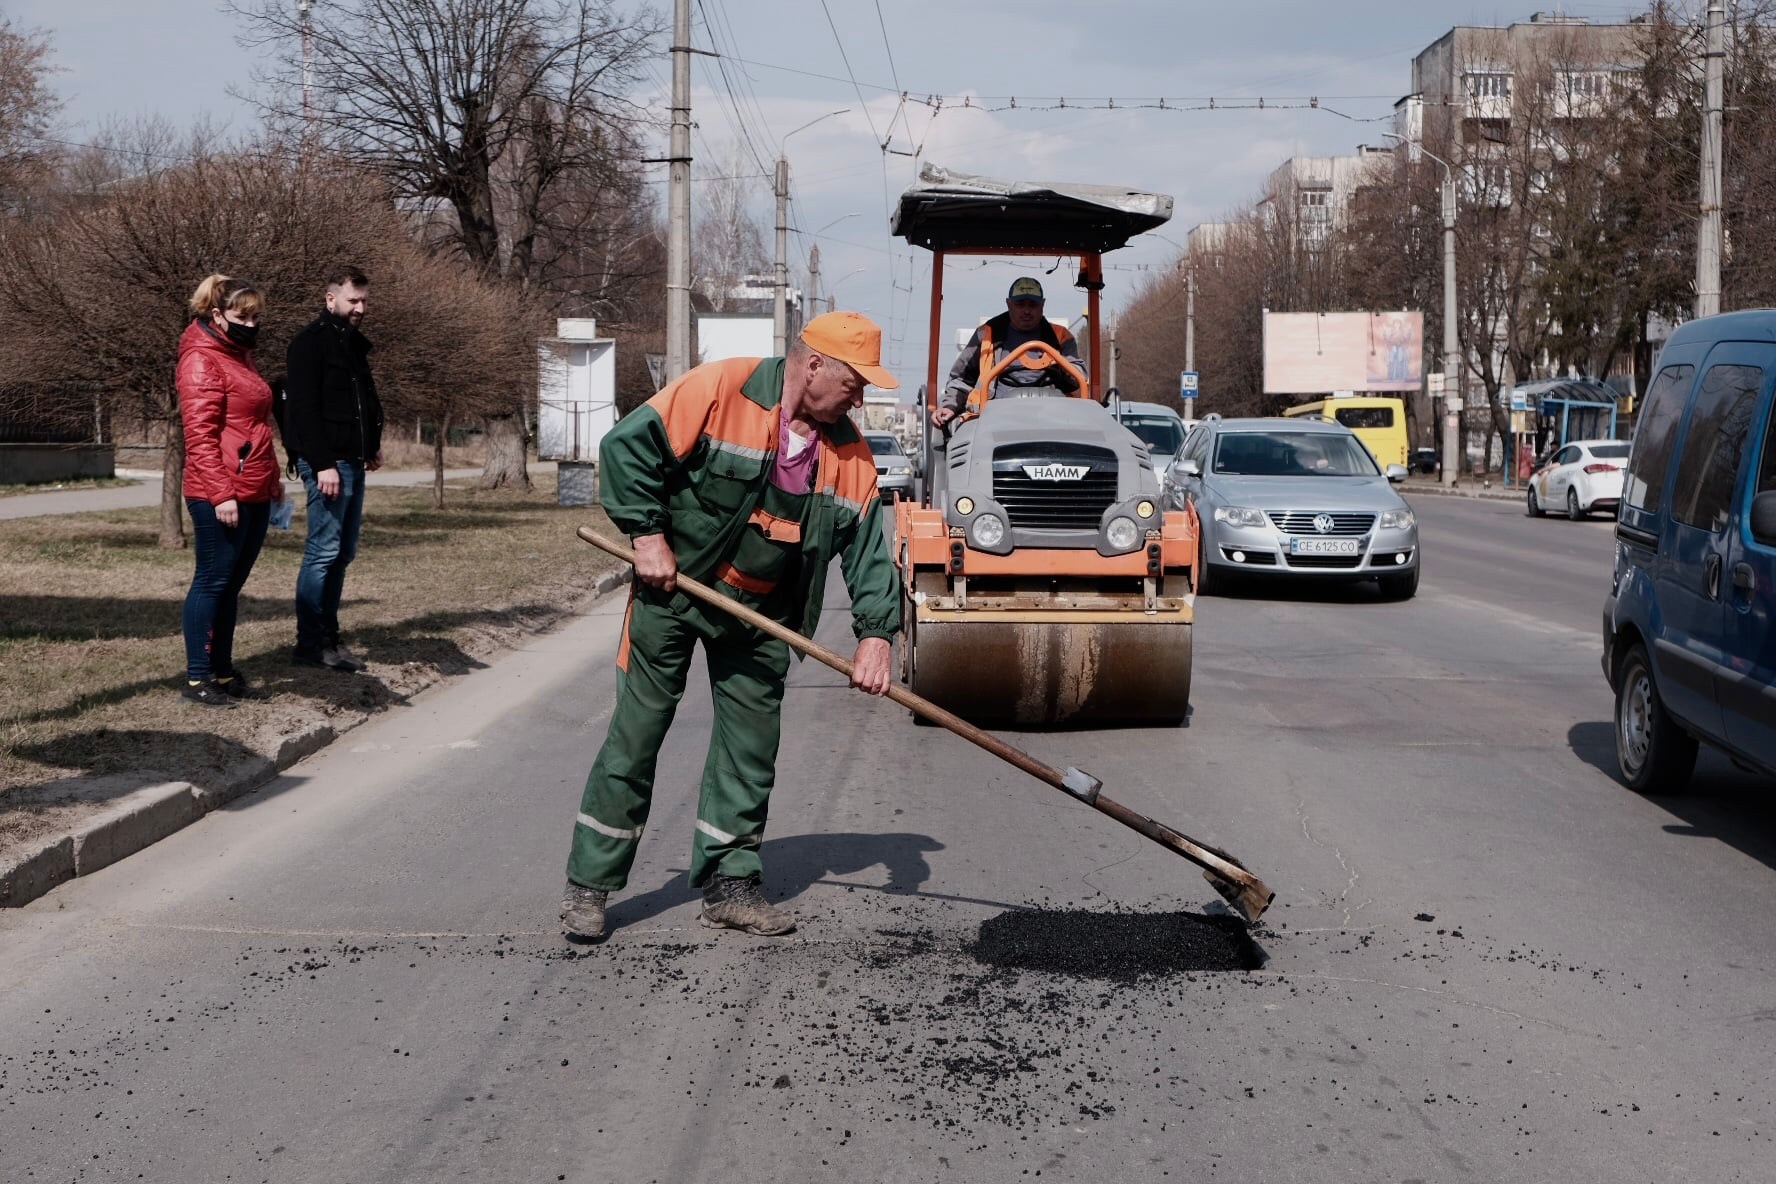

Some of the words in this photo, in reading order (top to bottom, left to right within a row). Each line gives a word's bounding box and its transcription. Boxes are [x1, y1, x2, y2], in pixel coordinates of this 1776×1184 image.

[1034, 467, 1079, 478] HAMM
[1299, 541, 1313, 551] CE
[1315, 541, 1338, 552] 6125
[1341, 541, 1355, 552] CO
